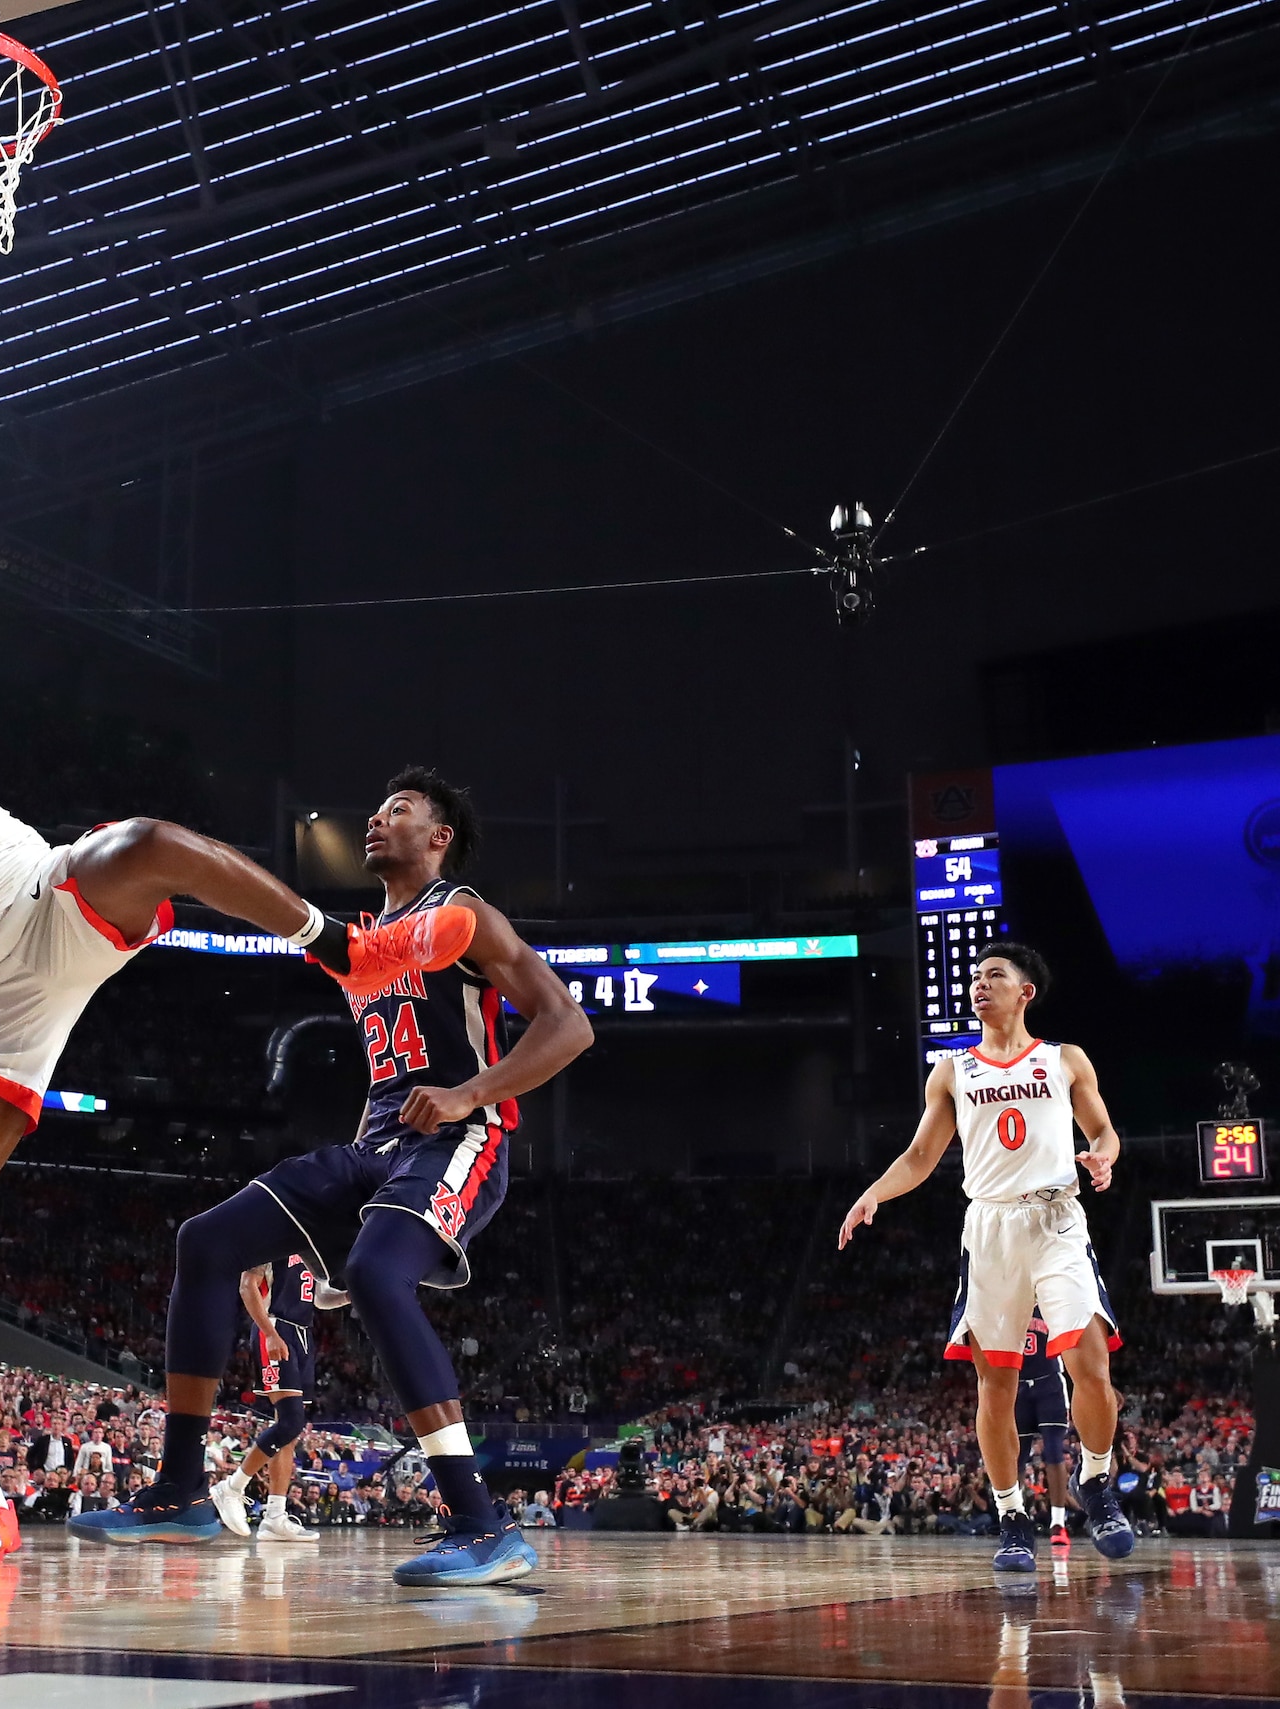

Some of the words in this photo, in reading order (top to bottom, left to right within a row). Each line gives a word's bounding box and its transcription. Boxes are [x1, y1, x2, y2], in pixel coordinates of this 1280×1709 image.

[945, 856, 972, 882] 54
[153, 929, 209, 950] ELCOME
[225, 934, 306, 955] MINNE
[927, 930, 934, 943] 1
[968, 926, 976, 939] 2
[985, 925, 993, 938] 1
[708, 941, 798, 958] CAVALIERS
[927, 949, 936, 961] 2
[952, 964, 961, 977] 5
[594, 975, 614, 1007] 4
[953, 1001, 962, 1014] 7
[363, 1000, 430, 1082] 24
[965, 1081, 1053, 1107] VIRGINIA
[997, 1106, 1027, 1152] 0
[1215, 1125, 1257, 1146] 2:56
[1212, 1144, 1255, 1177] 24
[299, 1270, 314, 1303] 2
